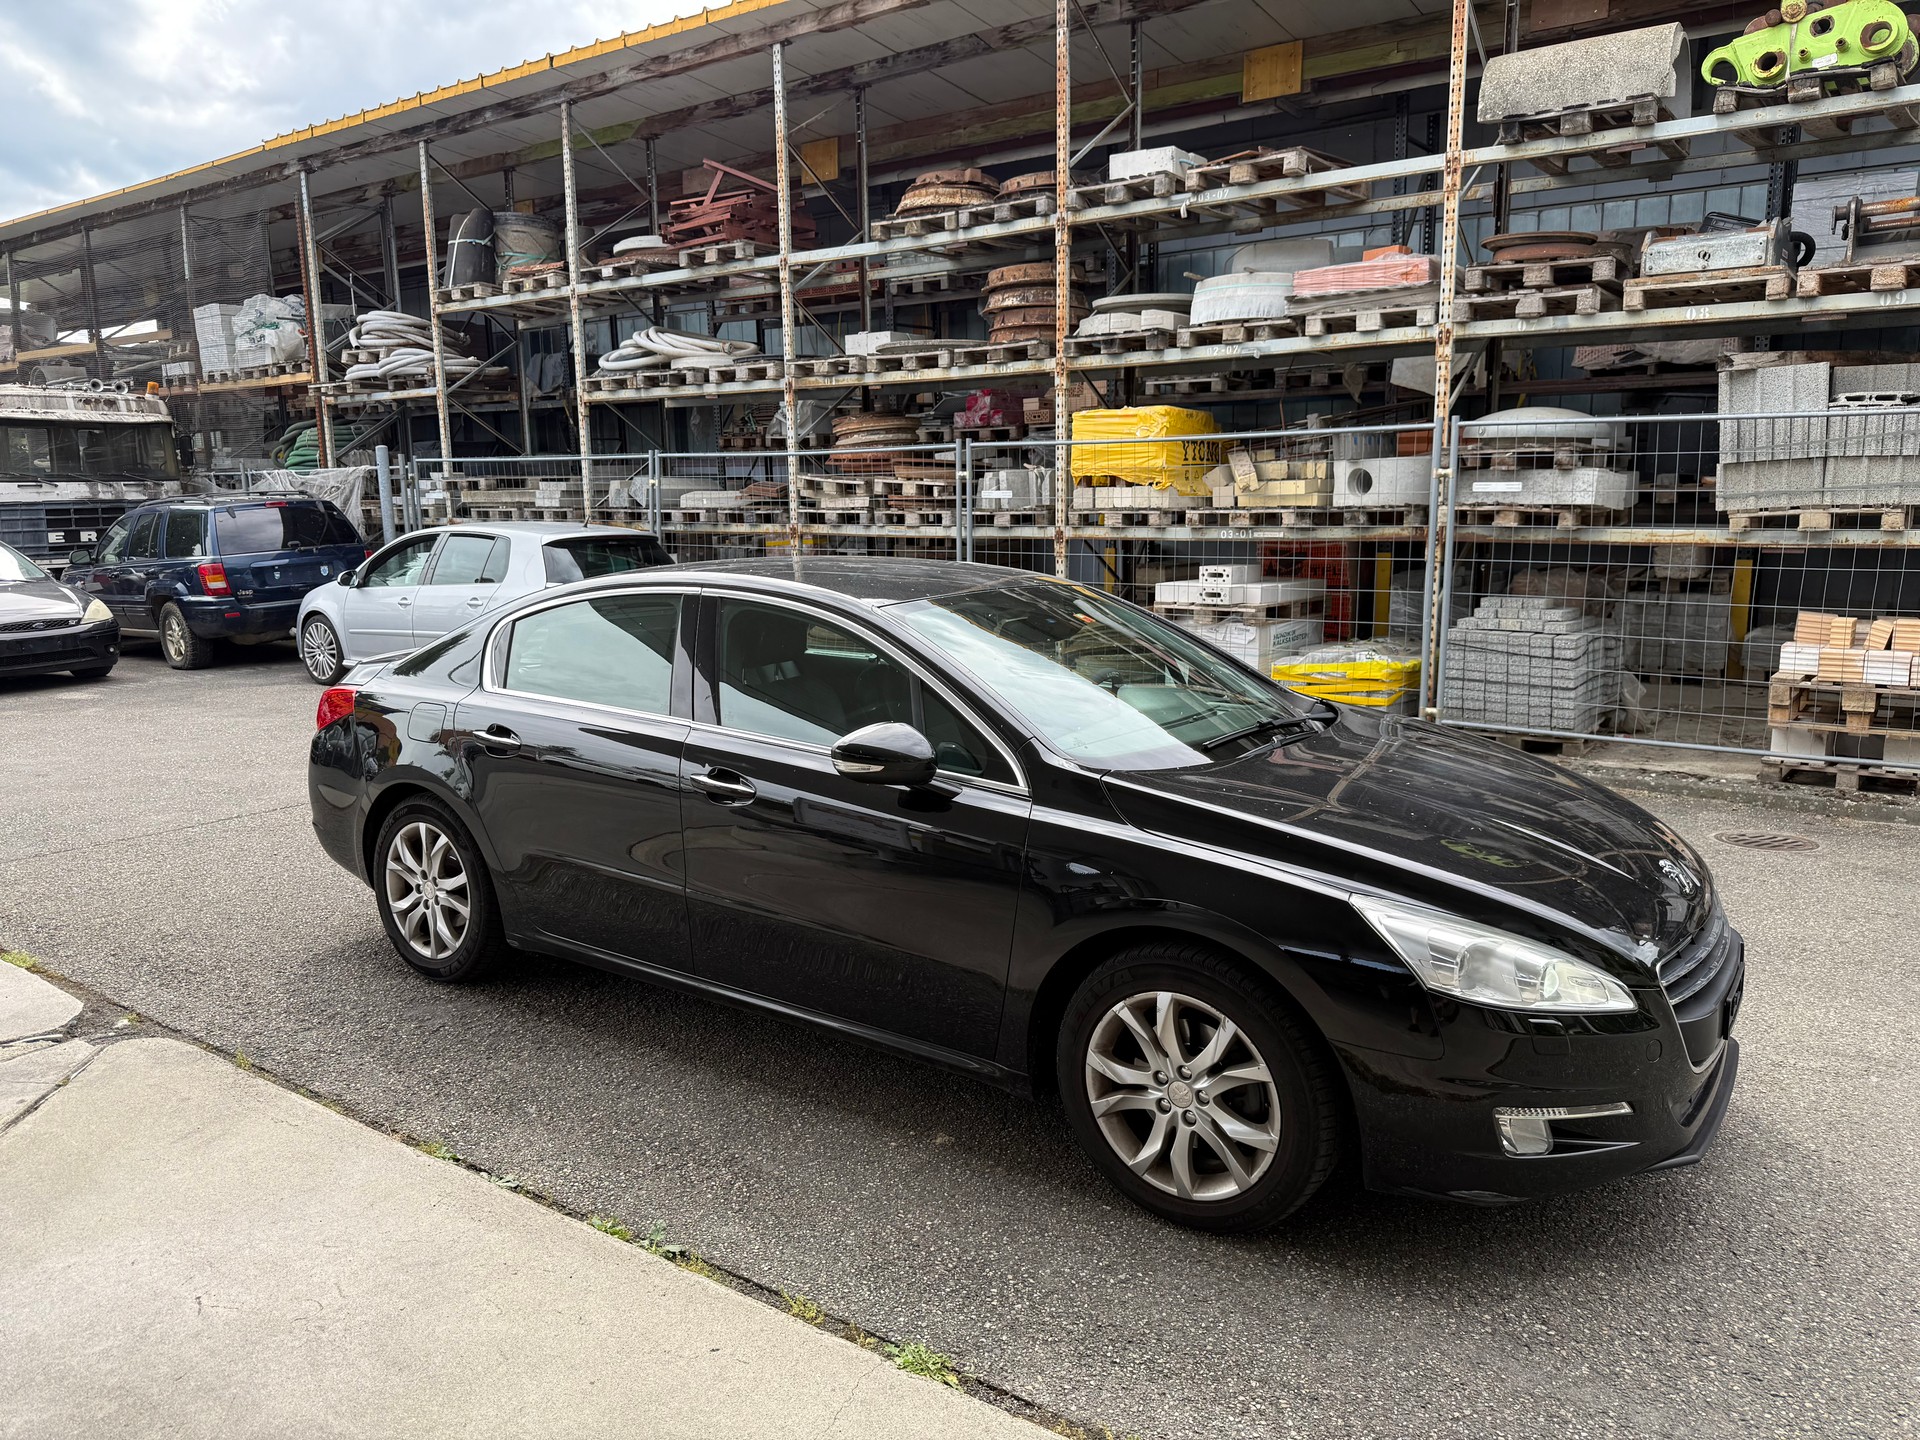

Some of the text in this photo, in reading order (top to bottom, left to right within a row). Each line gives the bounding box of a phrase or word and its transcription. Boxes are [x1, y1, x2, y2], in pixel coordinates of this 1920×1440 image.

[1880, 291, 1907, 307] 09
[1685, 306, 1710, 321] 08
[1220, 529, 1252, 539] 03-01
